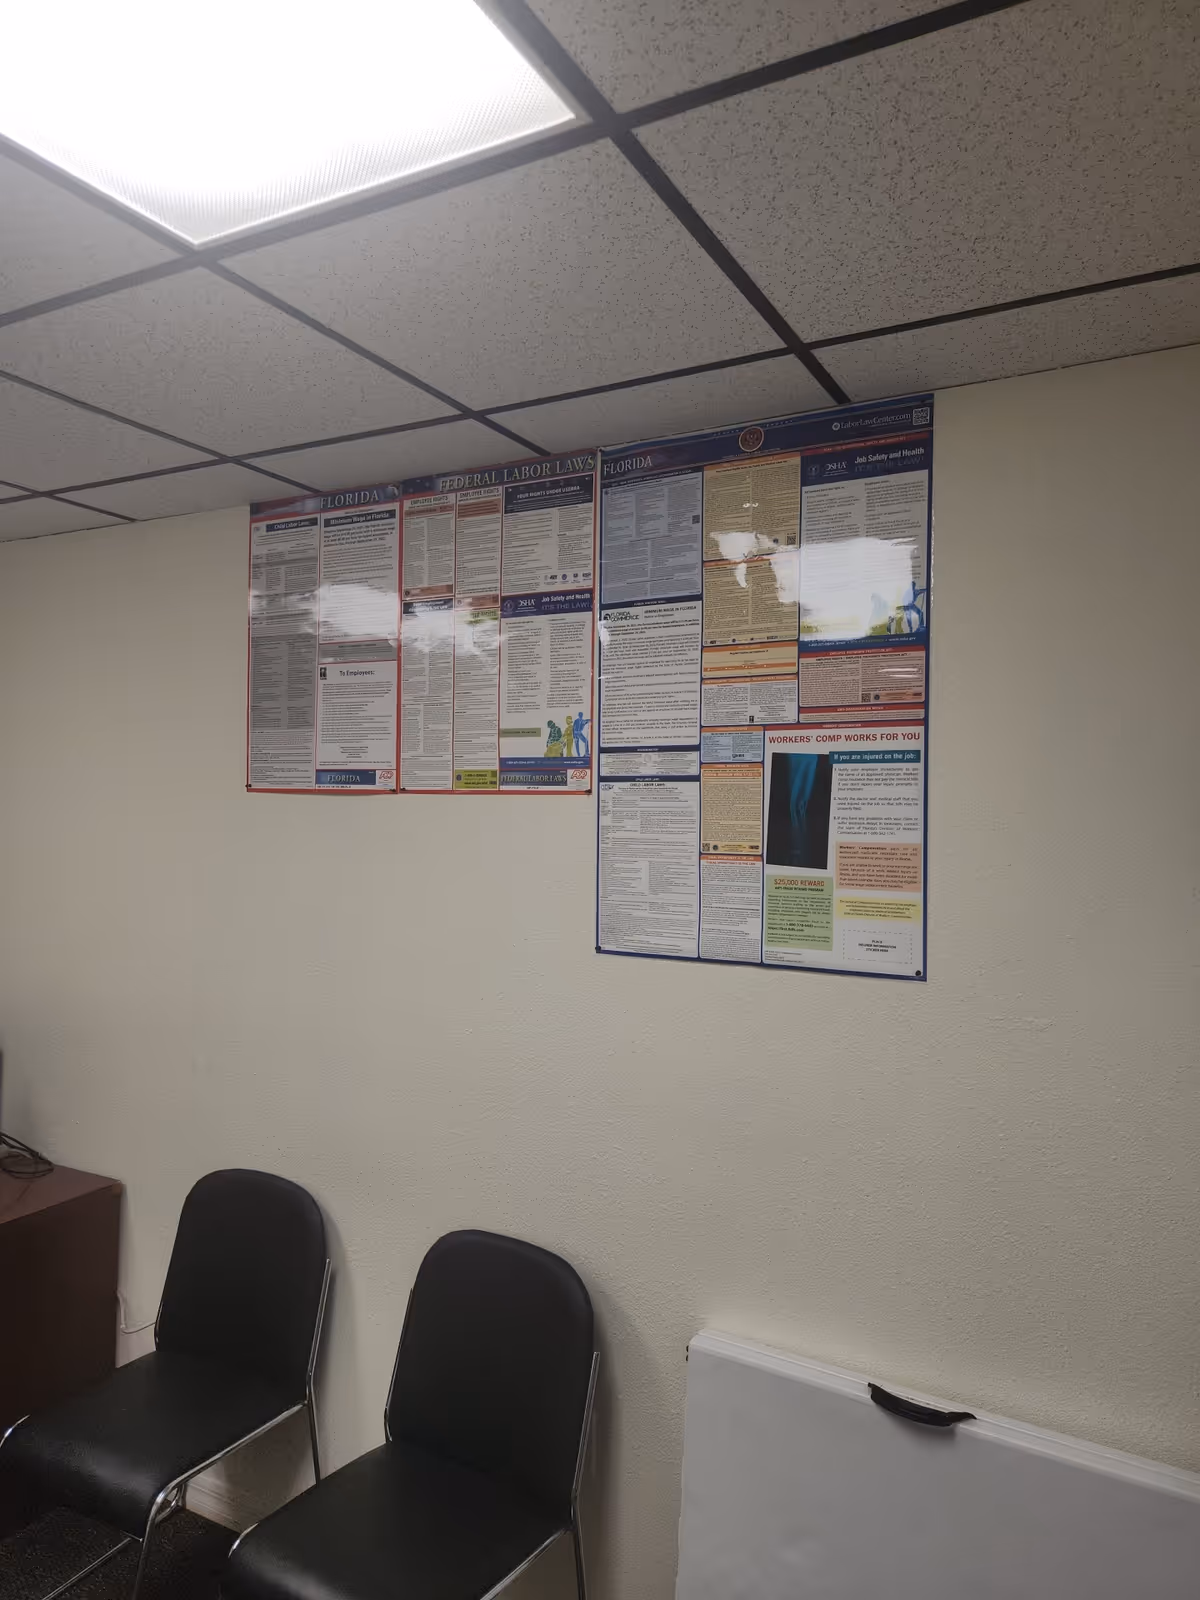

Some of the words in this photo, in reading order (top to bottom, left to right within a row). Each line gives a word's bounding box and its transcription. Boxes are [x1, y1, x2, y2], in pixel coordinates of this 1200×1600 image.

[840, 413, 911, 429] LaborLawCenter.com
[855, 455, 867, 464] Job
[868, 452, 888, 463] Safety
[889, 451, 901, 459] and
[902, 447, 925, 457] Health
[604, 455, 653, 475] FLORIDA
[440, 471, 499, 492] FEDERAL
[504, 462, 551, 482] LABOR
[556, 455, 595, 473] LAWS
[320, 490, 379, 509] FLORIDA
[371, 512, 389, 520] Florida
[346, 669, 375, 677] Employees:
[768, 735, 813, 744] WORKERS'
[815, 734, 842, 743] COMP
[844, 733, 877, 742] WORKS
[880, 733, 899, 741] FOR
[901, 732, 920, 741] YOU
[862, 753, 883, 761] injured
[904, 752, 916, 761] job:
[327, 774, 361, 783] FLORIDA
[774, 878, 799, 886] $25,000
